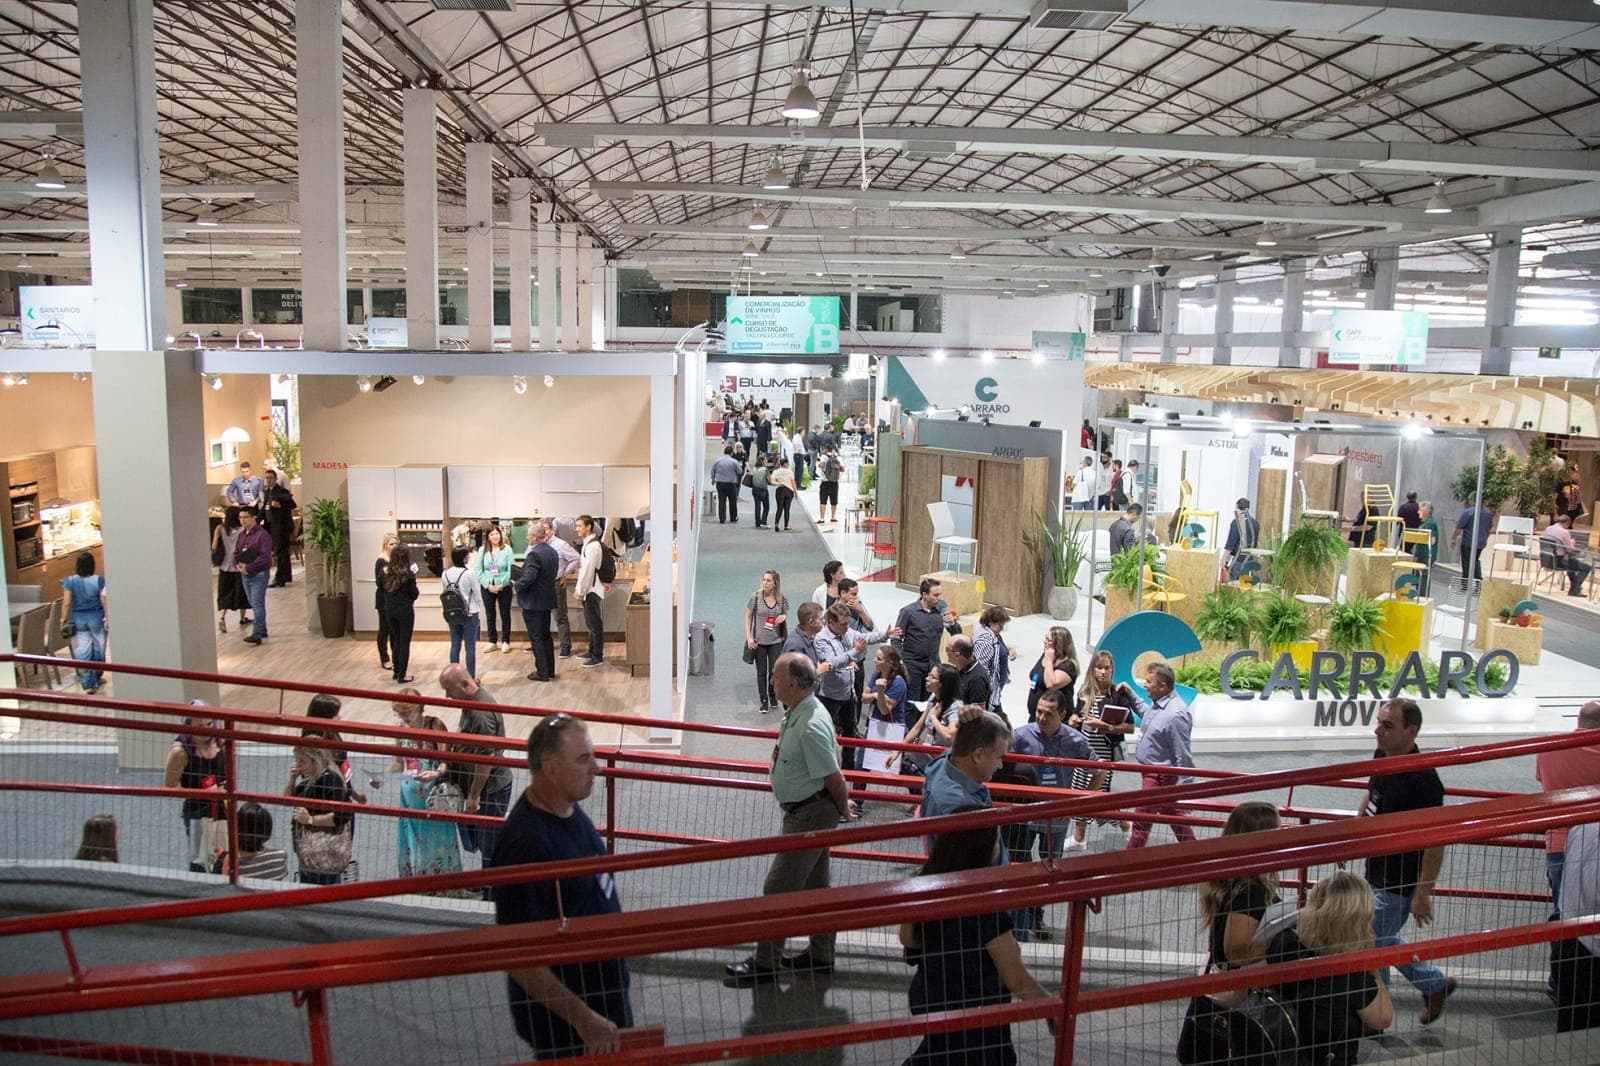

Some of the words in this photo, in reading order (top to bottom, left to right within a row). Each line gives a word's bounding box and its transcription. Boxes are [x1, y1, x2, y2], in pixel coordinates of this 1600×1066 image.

[739, 377, 798, 388] BLUME
[962, 403, 1010, 414] ARRARO
[1208, 439, 1240, 449] ASTOR
[312, 461, 348, 470] MADESA
[1220, 649, 1520, 701] CARRARO
[1314, 696, 1389, 727] MÓV
